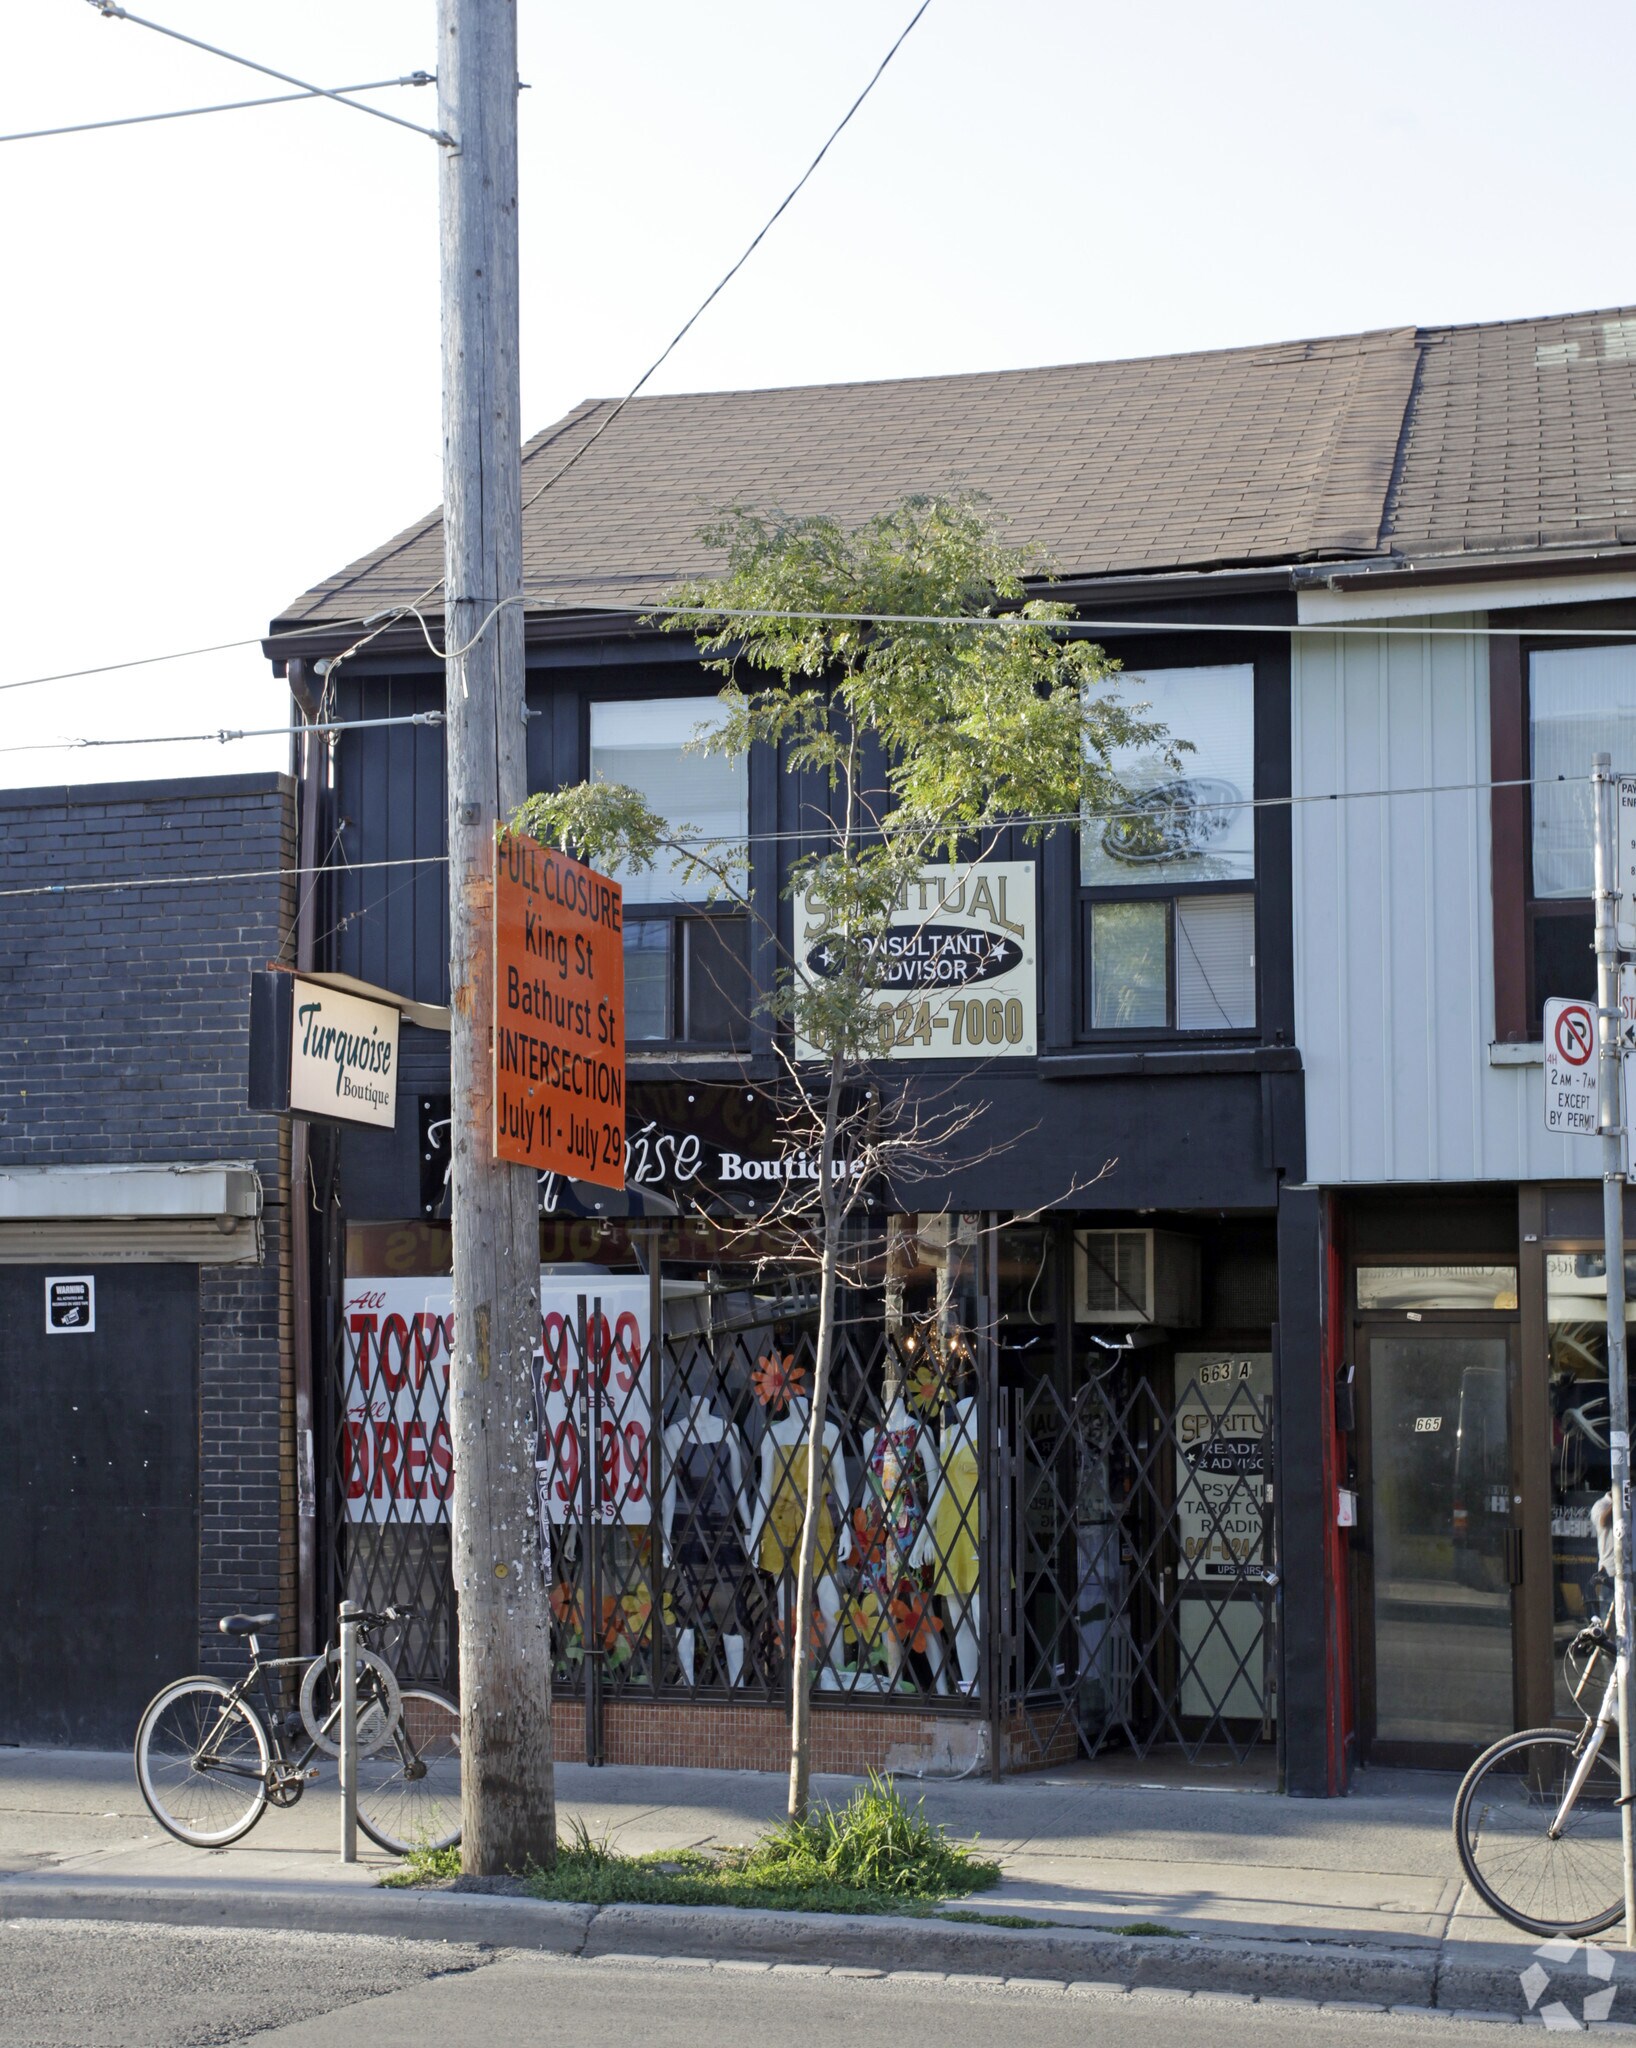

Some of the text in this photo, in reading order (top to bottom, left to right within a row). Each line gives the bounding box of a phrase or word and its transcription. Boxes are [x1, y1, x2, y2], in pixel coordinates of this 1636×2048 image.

[498, 836, 621, 933] FULL CLOSURE
[804, 876, 1025, 940] SITUAL
[525, 910, 593, 980] King St
[850, 934, 984, 956] ONSULTANT
[508, 965, 615, 1048] Bathurst St
[299, 1002, 391, 1097] Turquoise
[500, 1026, 621, 1108] INTERSECTION
[343, 1076, 389, 1110] Boutique
[1558, 1092, 1590, 1110] EXCEPT
[1550, 1111, 1595, 1129] BY PERMIT
[499, 1092, 534, 1153] July
[539, 1104, 551, 1147] 11
[567, 1114, 599, 1171] July
[603, 1124, 621, 1166] 29
[55, 1285, 85, 1294] WARNING
[345, 1290, 387, 1310] All
[1201, 1362, 1249, 1384] 663 A
[347, 1401, 387, 1418] All
[1417, 1418, 1440, 1431] 665
[1202, 1443, 1274, 1455] READE
[1185, 1501, 1241, 1515] TAROT
[1201, 1519, 1263, 1533] RADIN
[1217, 1565, 1261, 1575] UPSIRS
